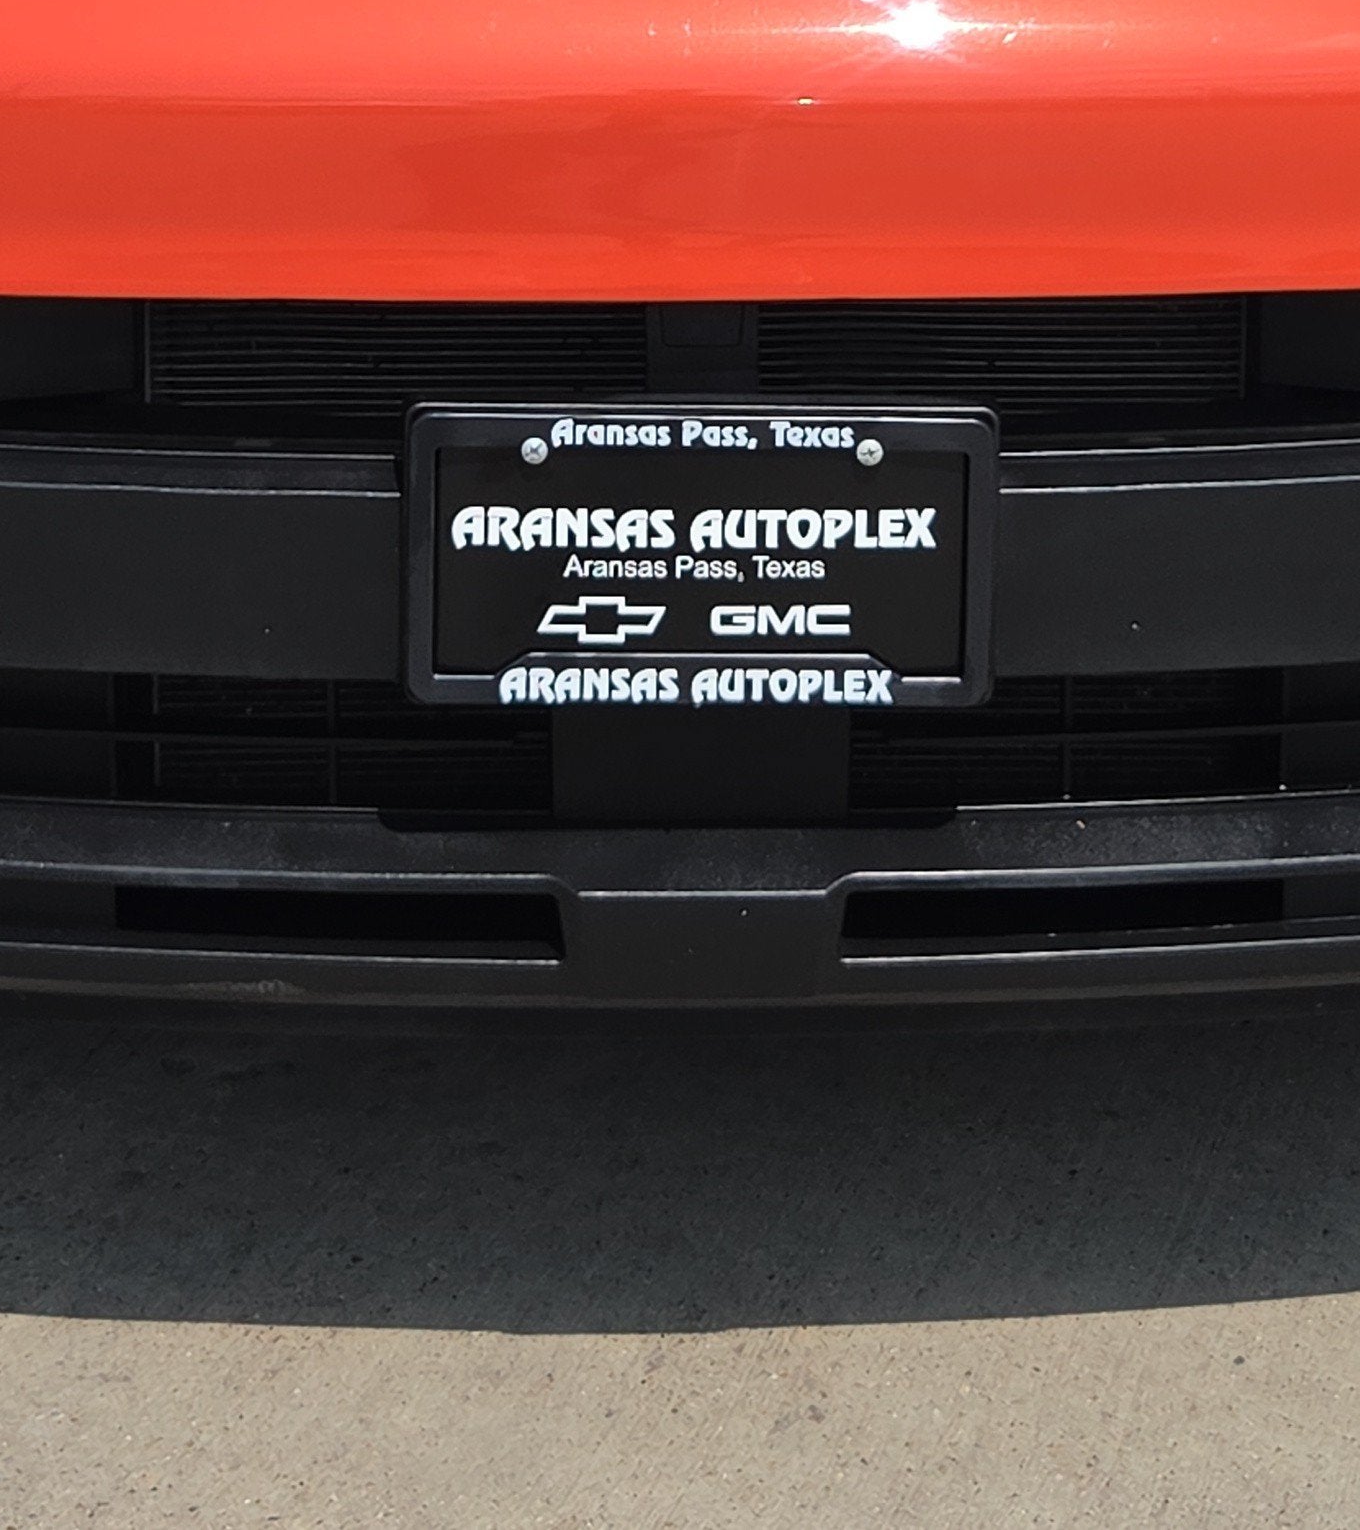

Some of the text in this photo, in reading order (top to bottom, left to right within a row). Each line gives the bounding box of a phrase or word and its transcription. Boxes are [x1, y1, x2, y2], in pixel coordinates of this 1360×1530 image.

[551, 418, 855, 450] Aransas Pass, Texas
[451, 506, 937, 552] ARANSAS AUTOPLEX
[562, 555, 826, 583] Aransas Pass, Texas
[710, 604, 852, 636] GMC
[499, 666, 894, 708] ARANSAS AUTOPLEX
